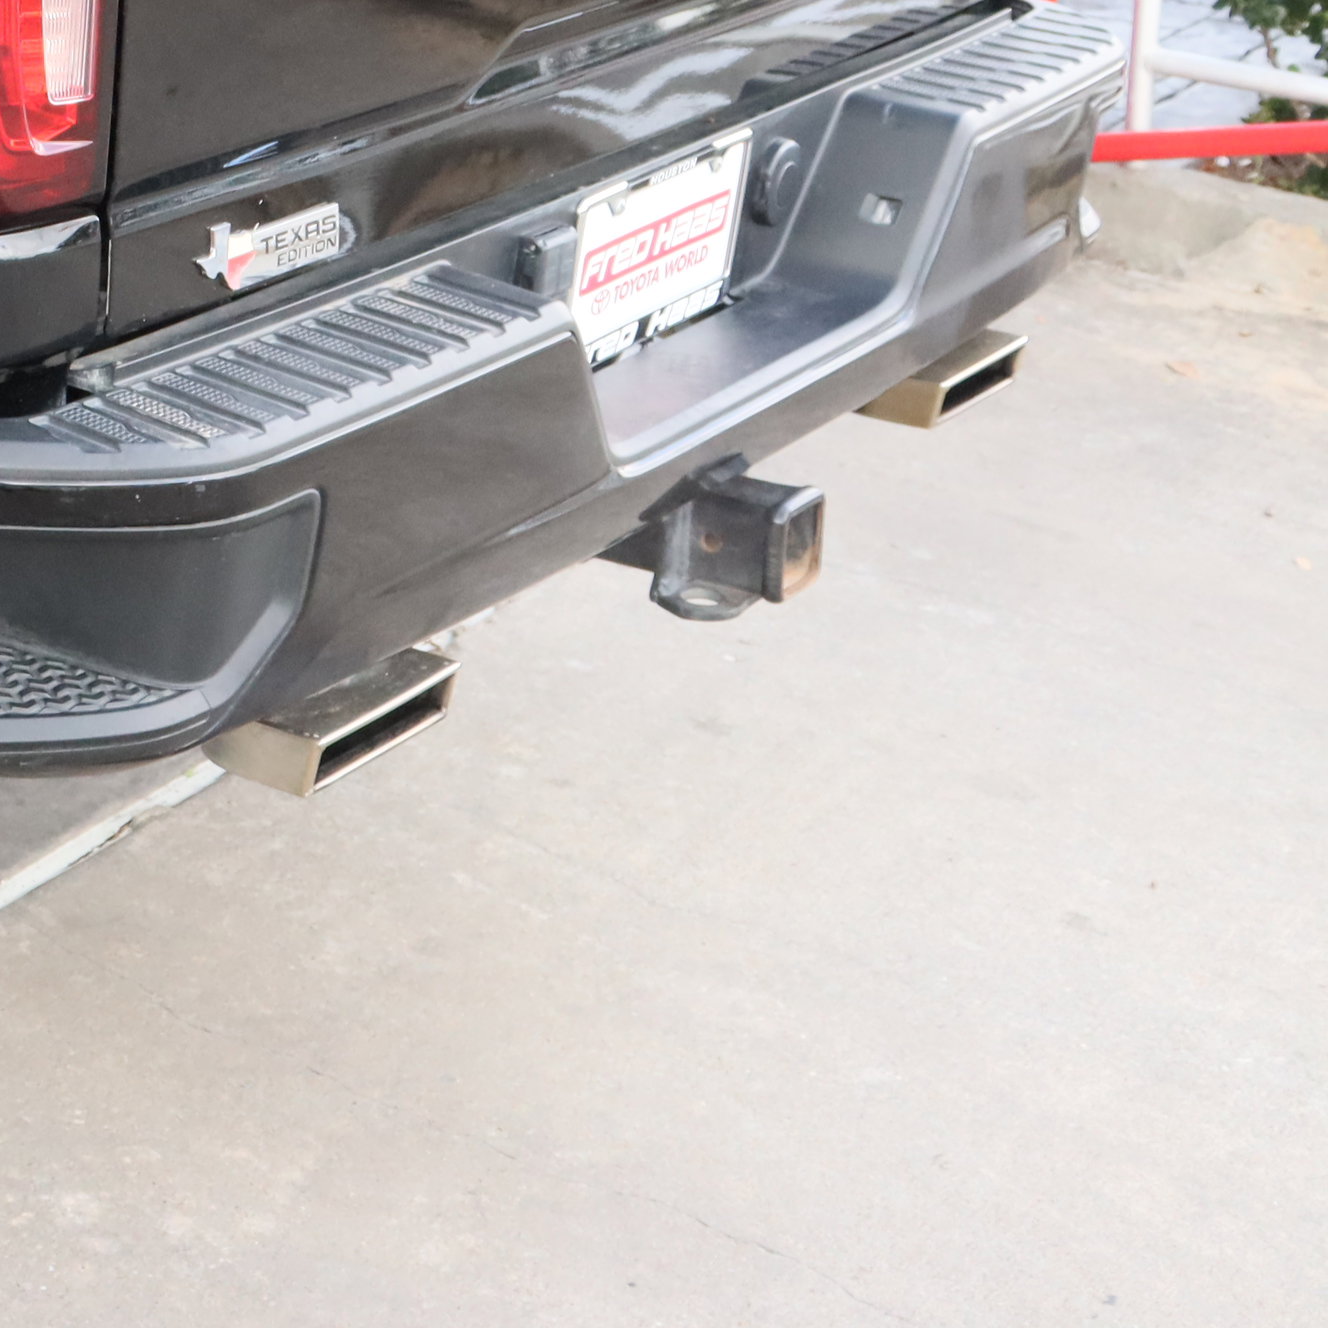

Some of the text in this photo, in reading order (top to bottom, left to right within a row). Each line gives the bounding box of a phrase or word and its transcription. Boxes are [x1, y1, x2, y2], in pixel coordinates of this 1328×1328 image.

[648, 157, 699, 186] HOUSTON
[260, 214, 338, 255] TEXAS
[276, 235, 338, 268] EDITION
[613, 244, 710, 305] TOYOTA WORLD
